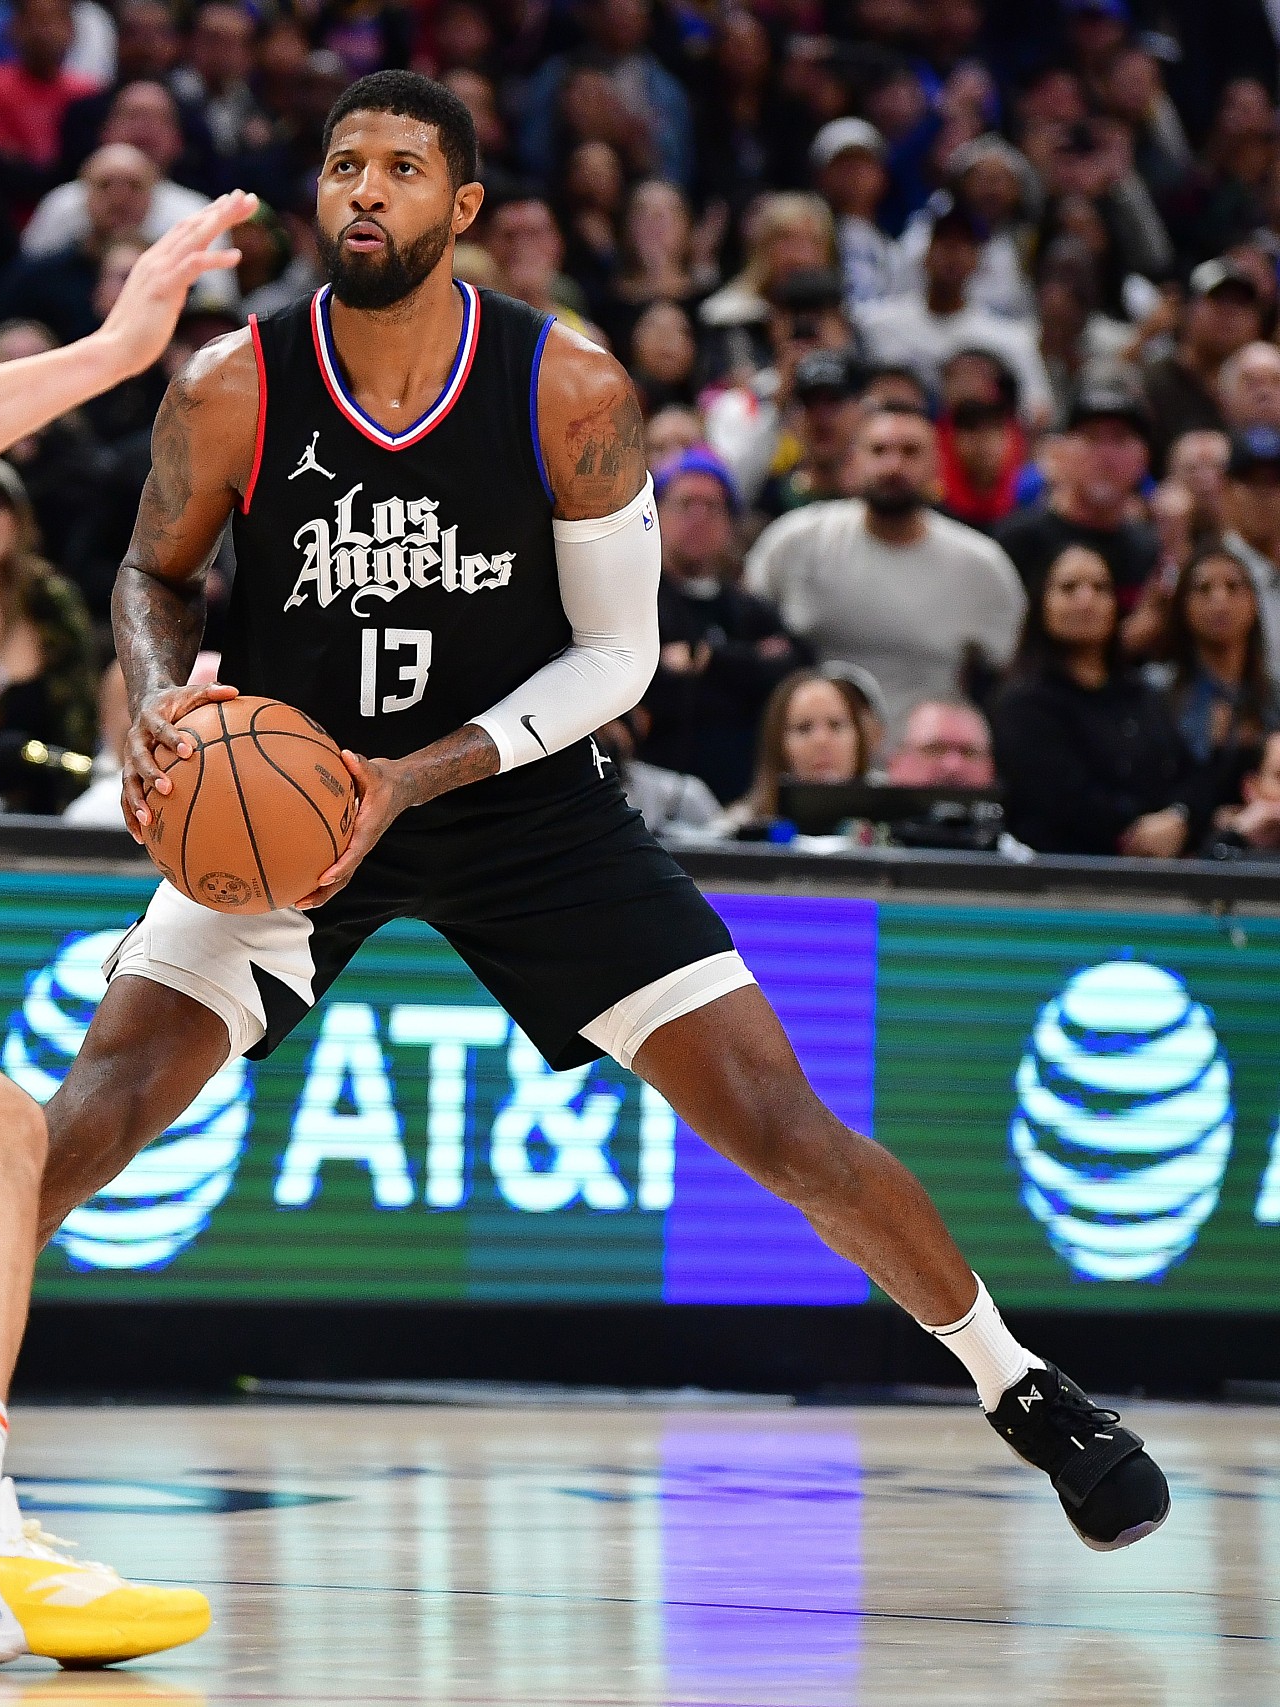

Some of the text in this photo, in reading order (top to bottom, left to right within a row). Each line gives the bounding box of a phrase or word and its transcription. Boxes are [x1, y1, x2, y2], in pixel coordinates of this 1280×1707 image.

[331, 482, 440, 550] Los
[283, 518, 517, 618] Angeles
[360, 628, 432, 717] 13
